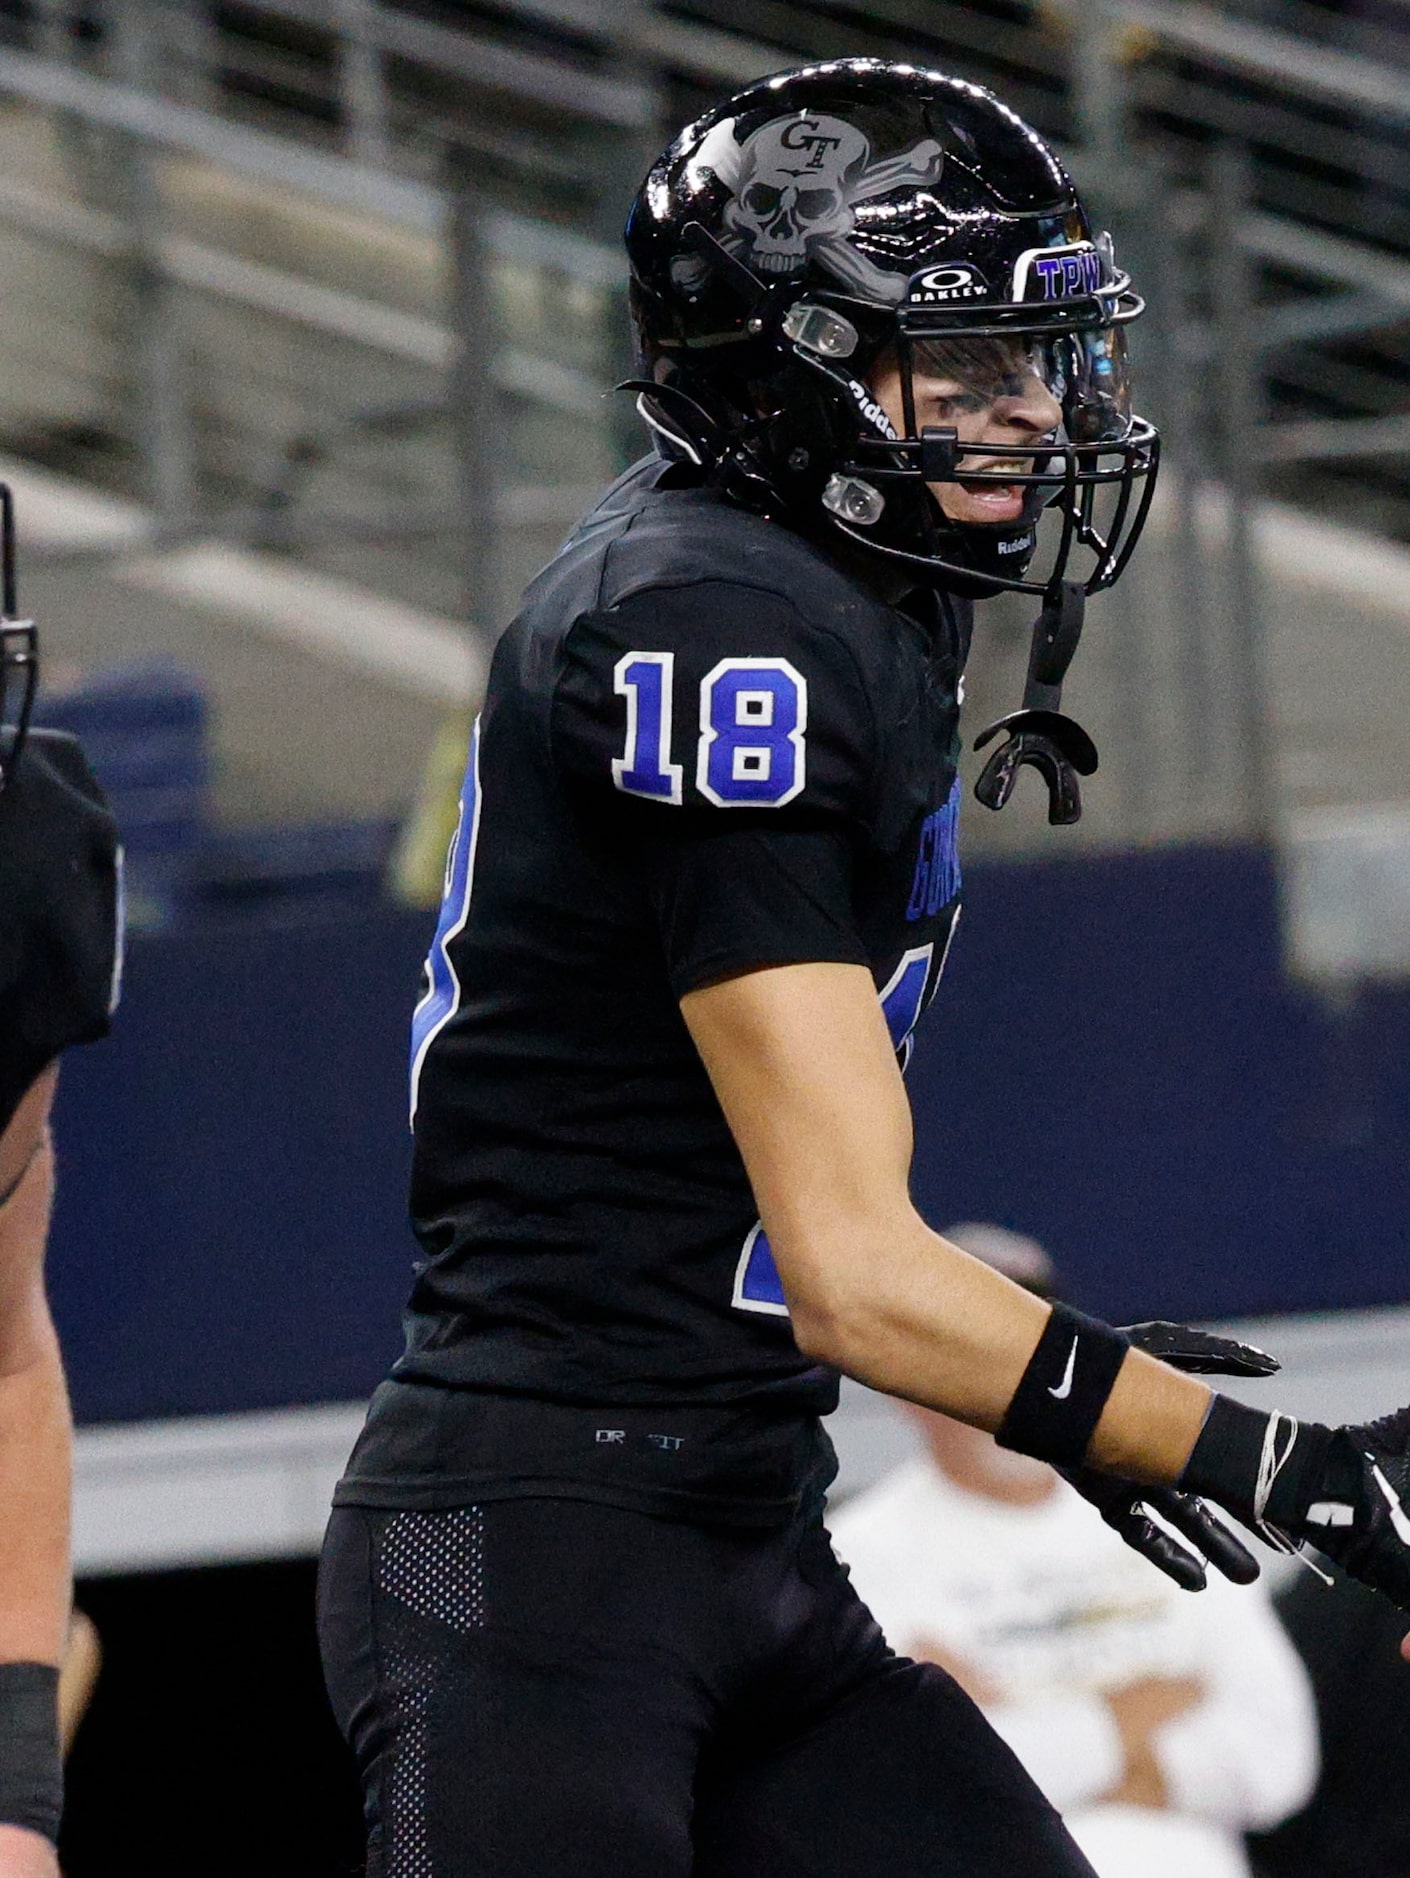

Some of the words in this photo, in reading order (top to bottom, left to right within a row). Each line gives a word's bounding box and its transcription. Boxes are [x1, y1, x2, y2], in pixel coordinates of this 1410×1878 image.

[781, 120, 842, 169] GT
[910, 286, 984, 303] OAKLEY
[611, 651, 808, 809] 18
